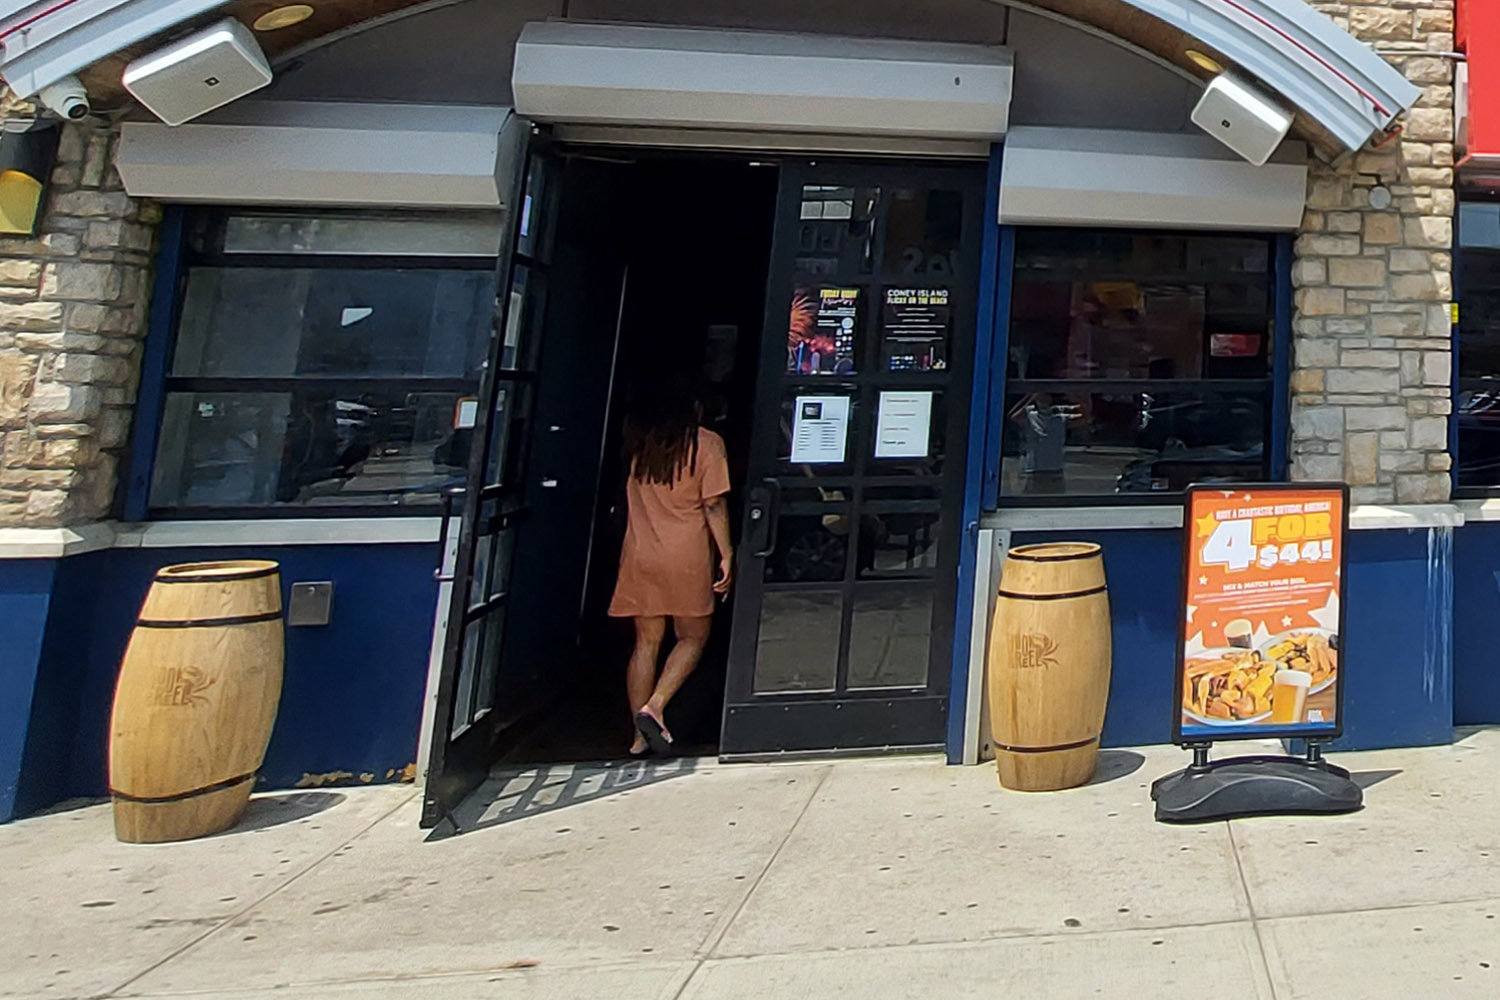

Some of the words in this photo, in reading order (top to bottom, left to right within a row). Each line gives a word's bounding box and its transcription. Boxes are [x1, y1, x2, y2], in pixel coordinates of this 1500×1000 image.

[887, 289, 916, 297] CONEY
[918, 289, 949, 298] ISLAND
[1201, 518, 1258, 571] 4
[1252, 513, 1331, 544] FOR
[1258, 538, 1333, 569] $44!
